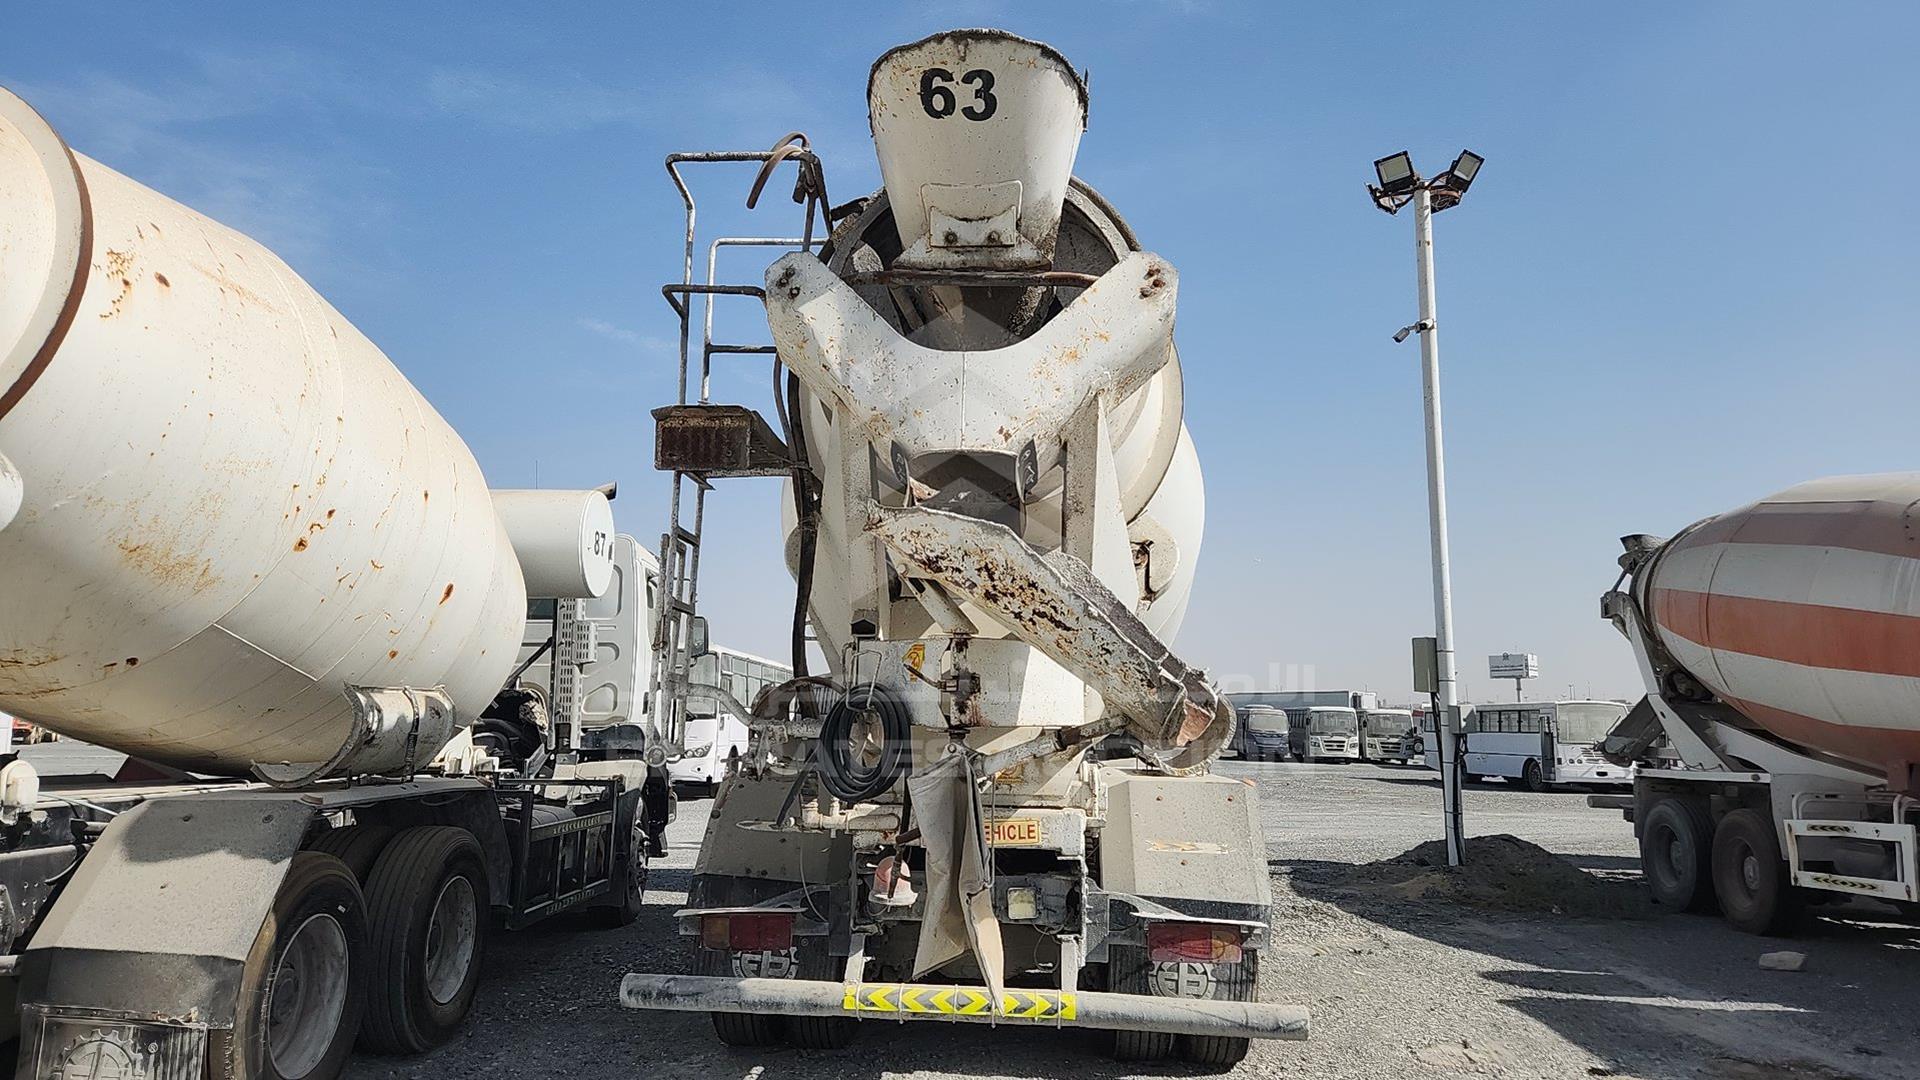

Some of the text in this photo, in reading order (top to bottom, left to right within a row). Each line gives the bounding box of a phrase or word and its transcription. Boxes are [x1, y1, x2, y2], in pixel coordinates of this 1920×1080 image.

[920, 67, 998, 122] 63
[593, 530, 606, 557] 87
[983, 824, 1037, 842] EHICLE
